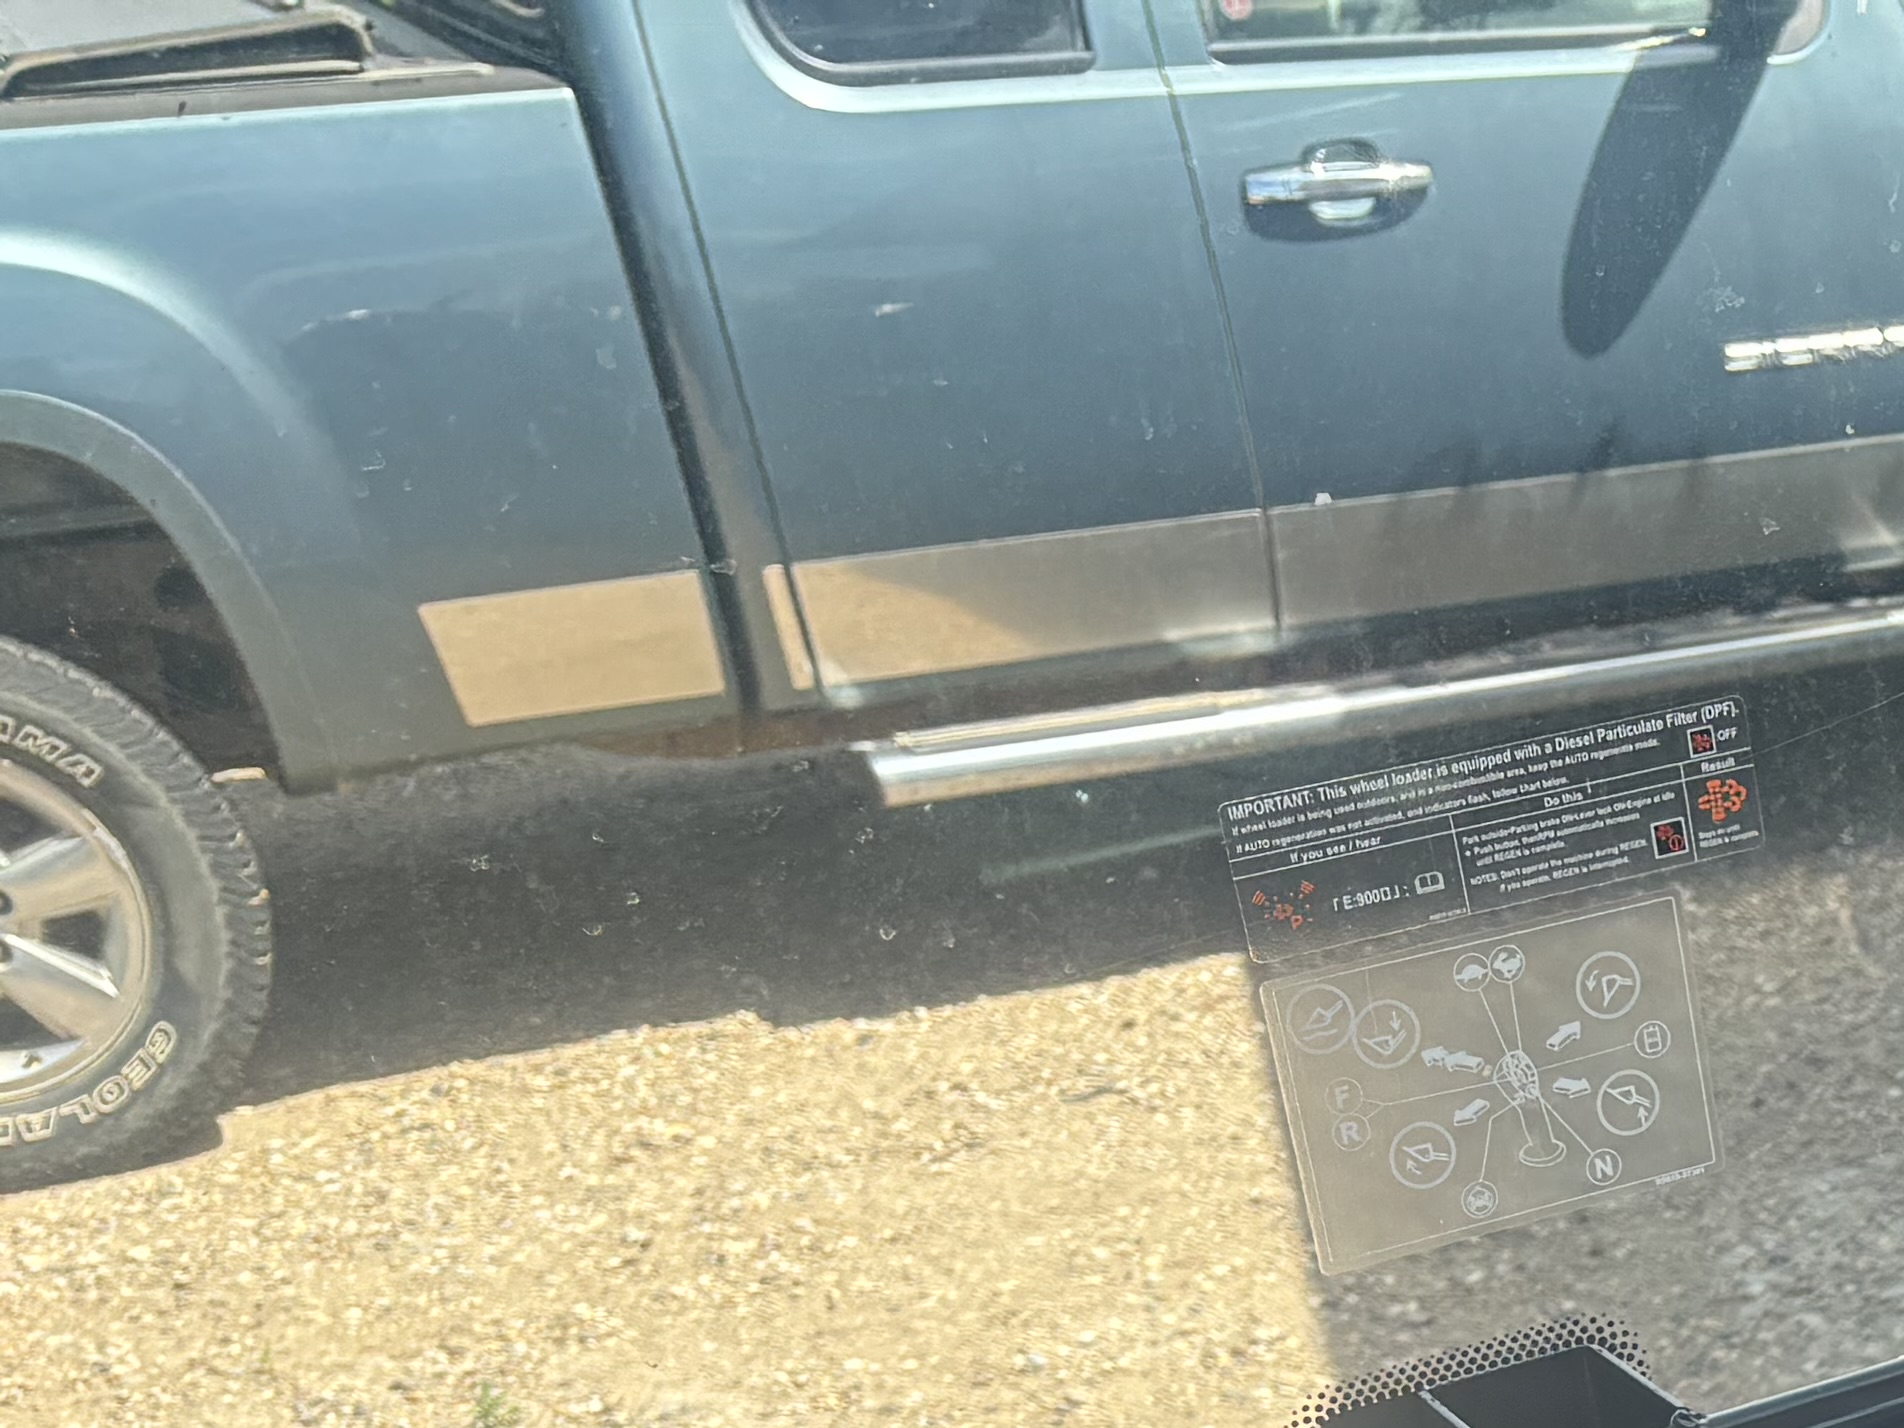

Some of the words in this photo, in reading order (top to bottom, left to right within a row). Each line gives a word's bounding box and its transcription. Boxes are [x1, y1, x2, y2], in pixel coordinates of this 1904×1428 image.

[0, 715, 103, 788] MA
[1228, 791, 1313, 820] IMPORTANT:
[1317, 785, 1347, 801] This
[1350, 775, 1389, 794] wheel
[1391, 768, 1432, 785] loader
[1436, 761, 1448, 777] is
[1451, 749, 1511, 773] equipped
[1514, 743, 1541, 760] with
[1545, 744, 1552, 753] a
[1555, 731, 1594, 751] Diesel
[1597, 719, 1663, 742] Particulate
[1666, 712, 1697, 727] Filter
[1268, 816, 1295, 828] loader
[1334, 802, 1355, 814] used
[1565, 752, 1588, 764] AUTO
[1544, 797, 1560, 807] Do
[1562, 792, 1583, 803] this
[1245, 839, 1270, 851] AUTO
[1290, 852, 1298, 862] If
[1301, 850, 1323, 862] you
[1326, 845, 1346, 854] see
[1355, 836, 1380, 848] hear
[0, 1020, 178, 1147] GEOLA
[1339, 1121, 1361, 1145] R
[1594, 1155, 1614, 1180] N
